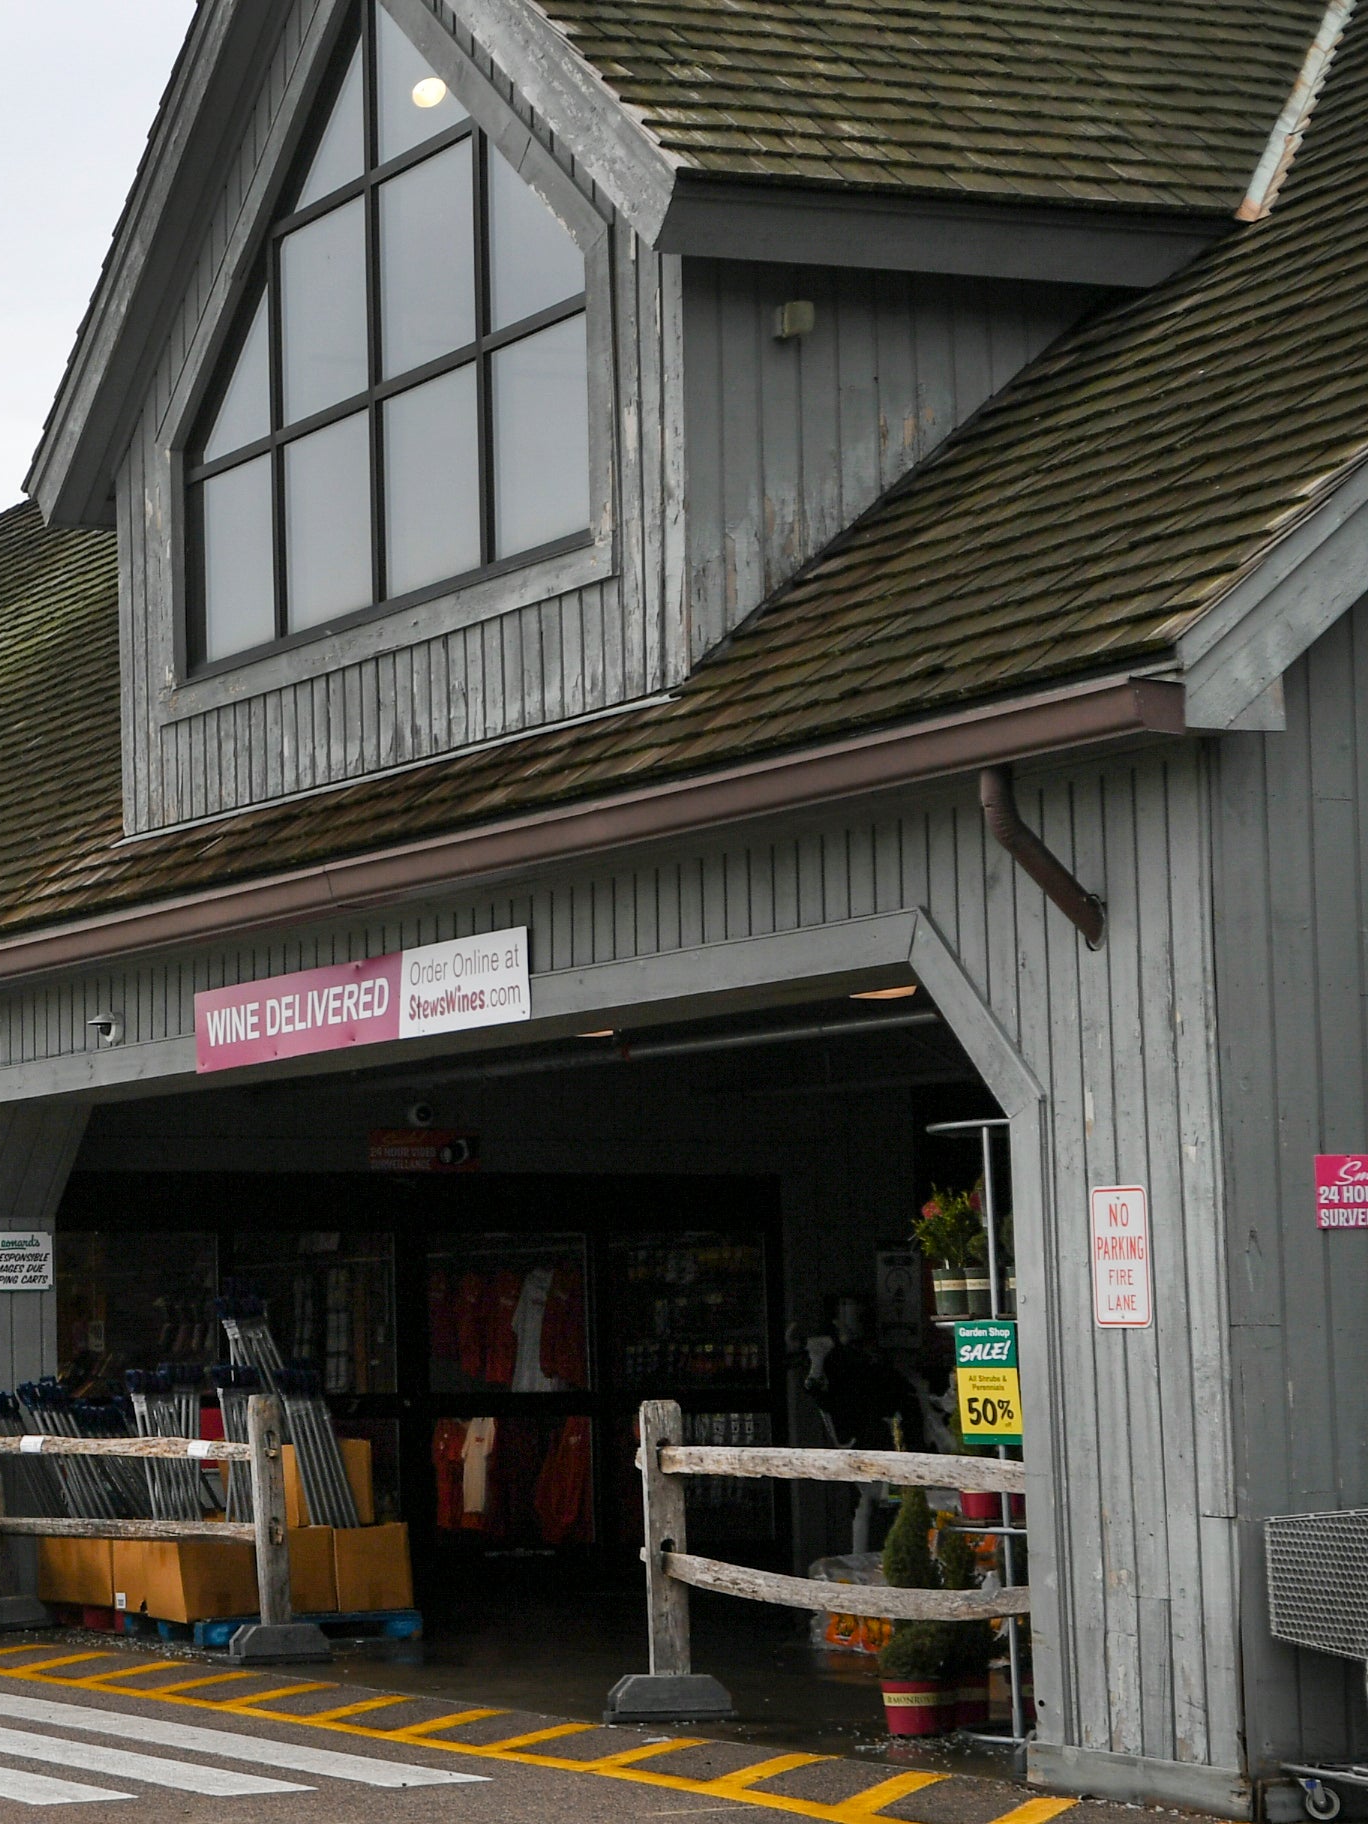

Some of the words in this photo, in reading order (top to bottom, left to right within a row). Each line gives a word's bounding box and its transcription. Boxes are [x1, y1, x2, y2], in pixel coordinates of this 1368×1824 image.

[409, 959, 448, 986] Order
[452, 951, 500, 978] Online
[504, 944, 520, 970] at
[206, 1001, 260, 1047] WINE
[265, 977, 390, 1036] DELIVERED
[408, 983, 522, 1021] StewsWines.com
[1319, 1185, 1340, 1204] 24
[1108, 1203, 1129, 1228] NO
[1096, 1235, 1144, 1261] PARKING
[26, 1263, 45, 1273] DUE
[1108, 1268, 1134, 1286] FIRE
[20, 1275, 49, 1284] CARTS
[1107, 1294, 1138, 1311] LANE
[959, 1327, 988, 1337] Garden
[988, 1326, 1010, 1338] Shop
[959, 1340, 1012, 1363] SALE!
[978, 1374, 1001, 1382] Shrubs
[967, 1397, 1014, 1426] 50%
